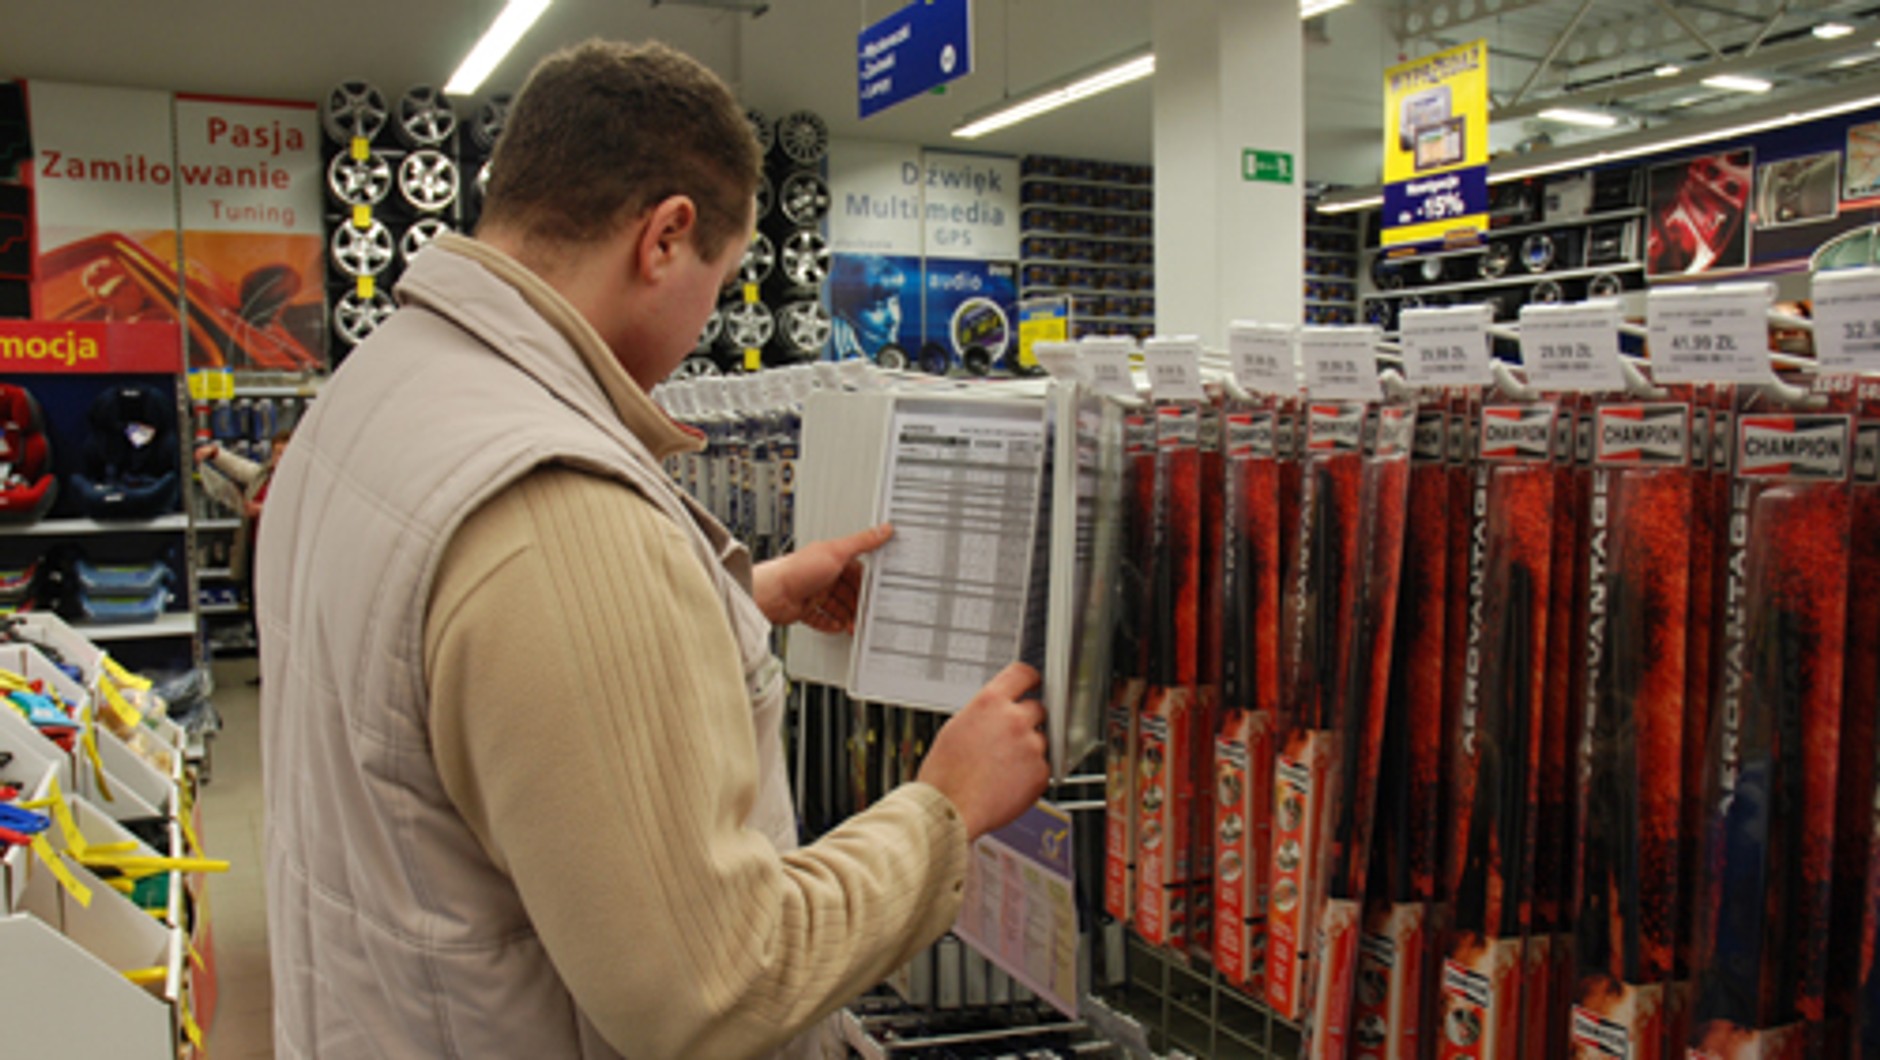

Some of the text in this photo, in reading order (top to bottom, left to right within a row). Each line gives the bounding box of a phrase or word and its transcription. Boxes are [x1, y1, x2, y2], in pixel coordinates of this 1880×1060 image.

[207, 117, 305, 155] Pasja
[902, 162, 1003, 196] Dźwięk
[210, 200, 296, 226] Tuning
[846, 194, 1006, 227] Multimedia
[935, 229, 973, 247] GPS
[1487, 424, 1548, 441] CHAMPION
[1603, 423, 1680, 445] CHAMPION
[1744, 436, 1841, 459] CHAMPION
[1462, 466, 1488, 756] AEROVANTAGE
